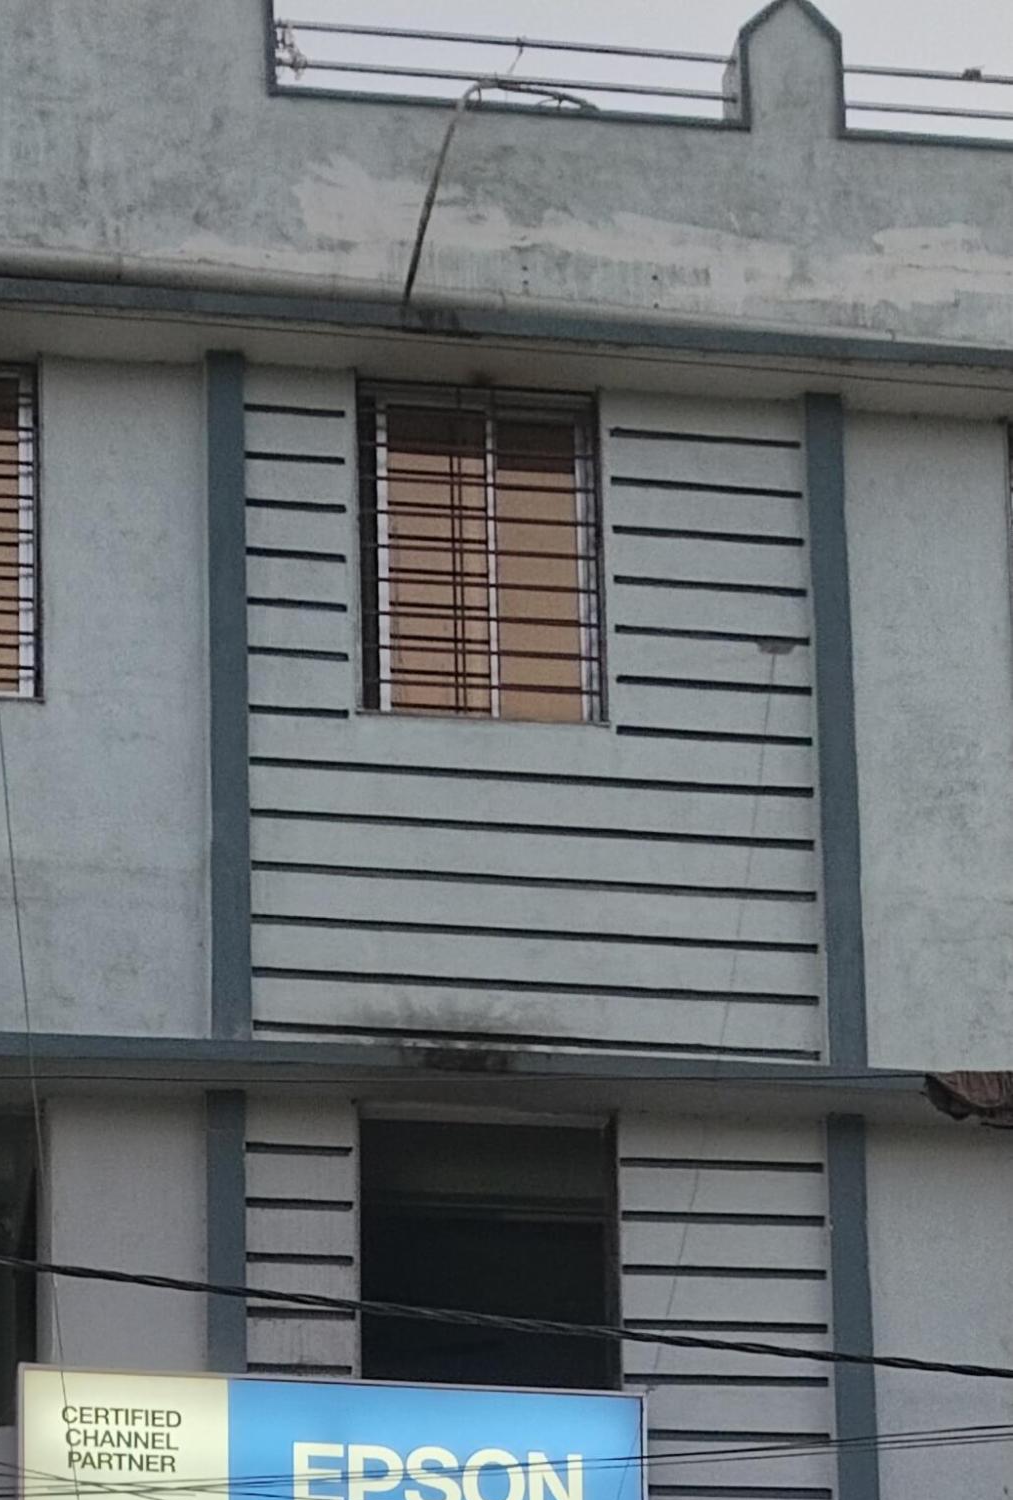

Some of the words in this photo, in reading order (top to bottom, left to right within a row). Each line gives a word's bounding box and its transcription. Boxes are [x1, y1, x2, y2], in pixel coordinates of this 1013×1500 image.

[61, 1405, 182, 1428] CERTIFIED
[65, 1428, 179, 1450] CHANNEL
[67, 1451, 176, 1473] PARTNER
